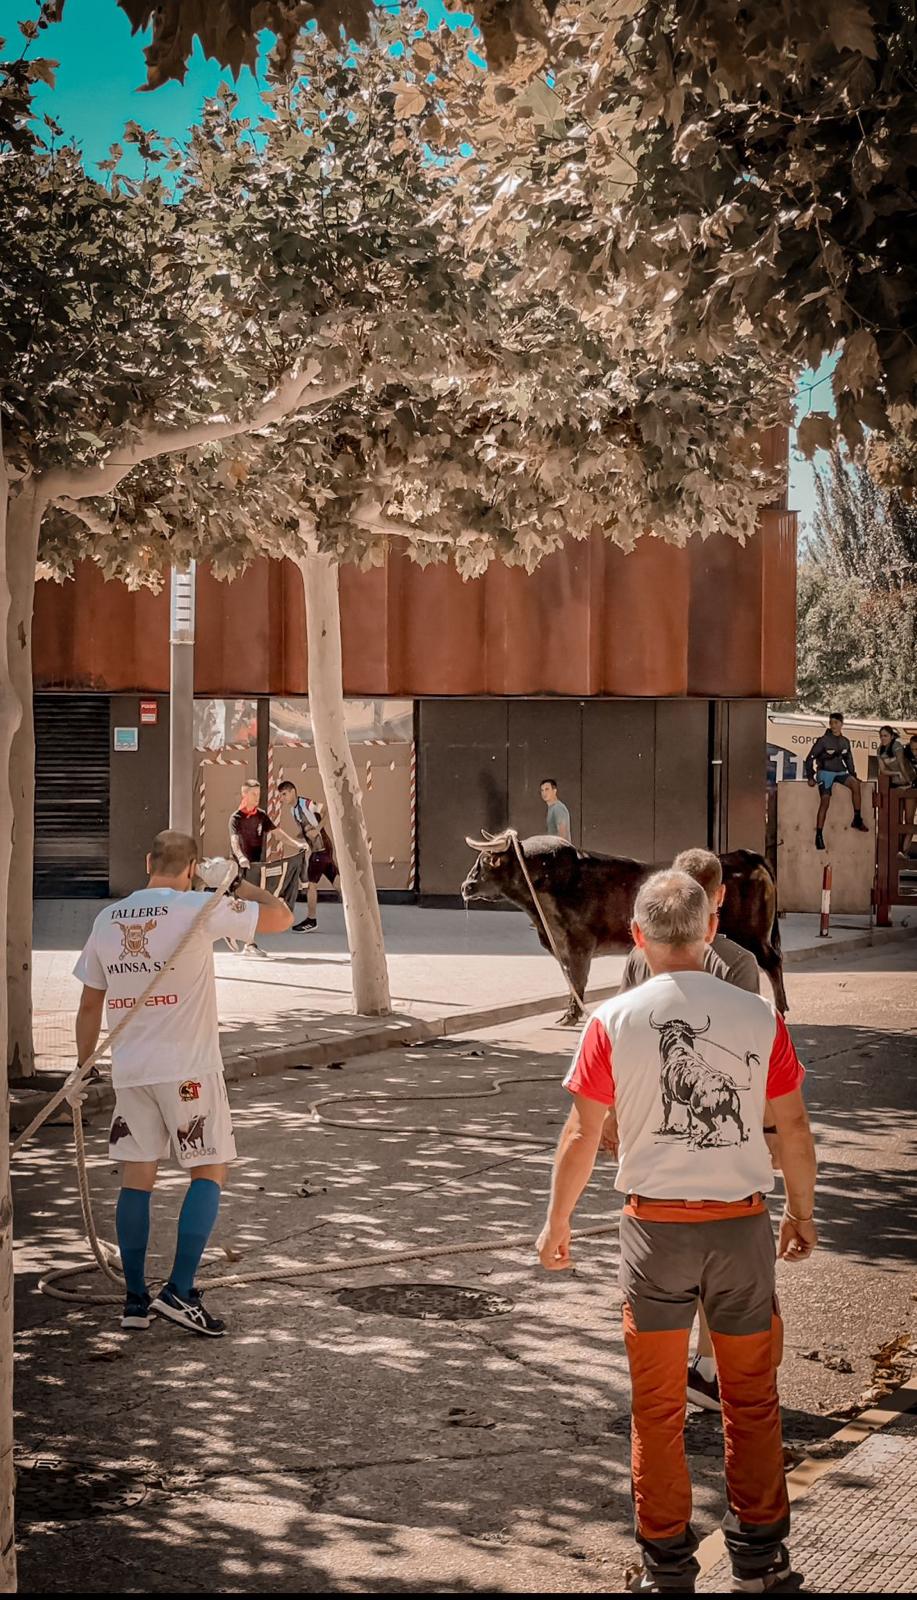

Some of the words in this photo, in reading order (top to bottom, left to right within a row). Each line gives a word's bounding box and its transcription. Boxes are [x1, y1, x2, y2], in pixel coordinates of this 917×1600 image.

[791, 735, 818, 745] SOPO
[852, 740, 869, 750] TAL
[111, 906, 169, 920] TALLERES
